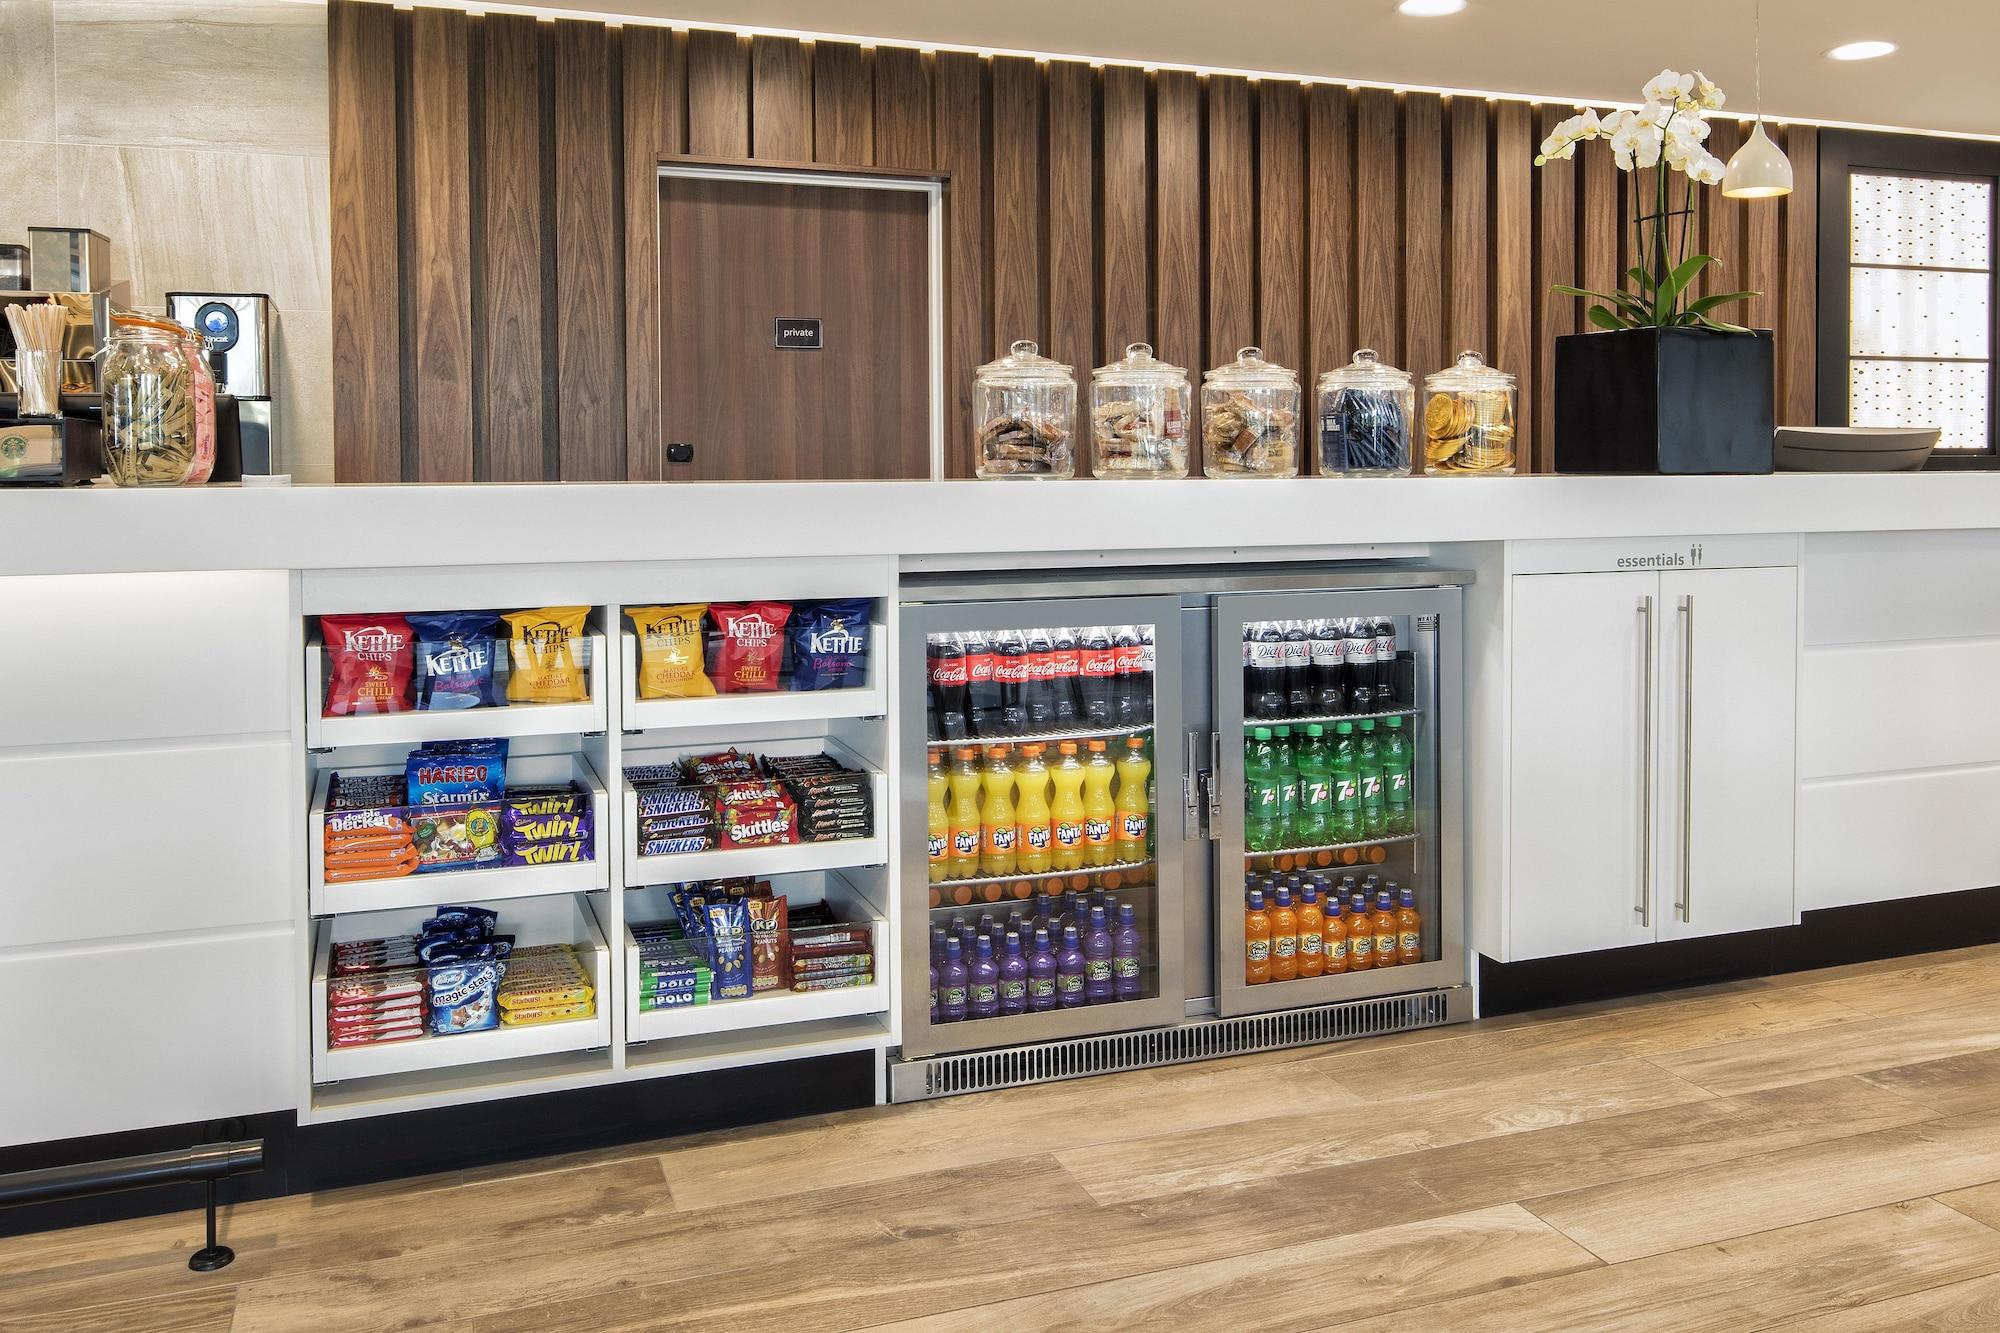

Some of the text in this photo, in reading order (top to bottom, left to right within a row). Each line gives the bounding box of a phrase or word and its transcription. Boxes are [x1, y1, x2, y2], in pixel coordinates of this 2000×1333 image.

[783, 327, 814, 338] private
[1617, 553, 1685, 567] essentials
[522, 621, 573, 645] KETTLE
[646, 615, 700, 639] KETTLE
[726, 614, 778, 639] KETTLE
[343, 626, 405, 652] KETTLE
[656, 635, 691, 647] CHIPS
[736, 638, 768, 647] CHIPS
[810, 629, 863, 654] KETTLE
[1257, 644, 1279, 658] Diet
[1285, 643, 1304, 658] Diet
[1315, 643, 1336, 656] Diet
[1345, 641, 1364, 654] Diet
[358, 652, 392, 661] CHIPS
[425, 648, 489, 677] KETTLE
[734, 670, 767, 679] CHILLI
[357, 687, 394, 697] CHILLI
[696, 760, 751, 774] Skittles
[418, 766, 487, 785] HARIBO
[422, 789, 489, 804] Starmix
[641, 790, 701, 806] SNICKERS
[724, 789, 780, 805] Skittles
[510, 797, 574, 815] Twirl
[645, 800, 704, 816] SNICKERS
[344, 809, 380, 821] double
[332, 814, 392, 832] Decker
[513, 815, 580, 841] Twirl
[730, 819, 789, 842] Skittles
[993, 832, 1016, 845] FANT
[1028, 831, 1051, 845] FANT
[514, 840, 581, 865] Twirl
[646, 838, 705, 855] SNICKERS
[754, 920, 775, 930] KP
[718, 946, 743, 954] PEANUTS
[434, 988, 468, 1006] magic
[468, 969, 494, 993] stars
[659, 978, 695, 988] POLO
[511, 996, 541, 1005] Starburst
[656, 993, 693, 1005] POLO
[514, 1011, 543, 1021] Starburst
